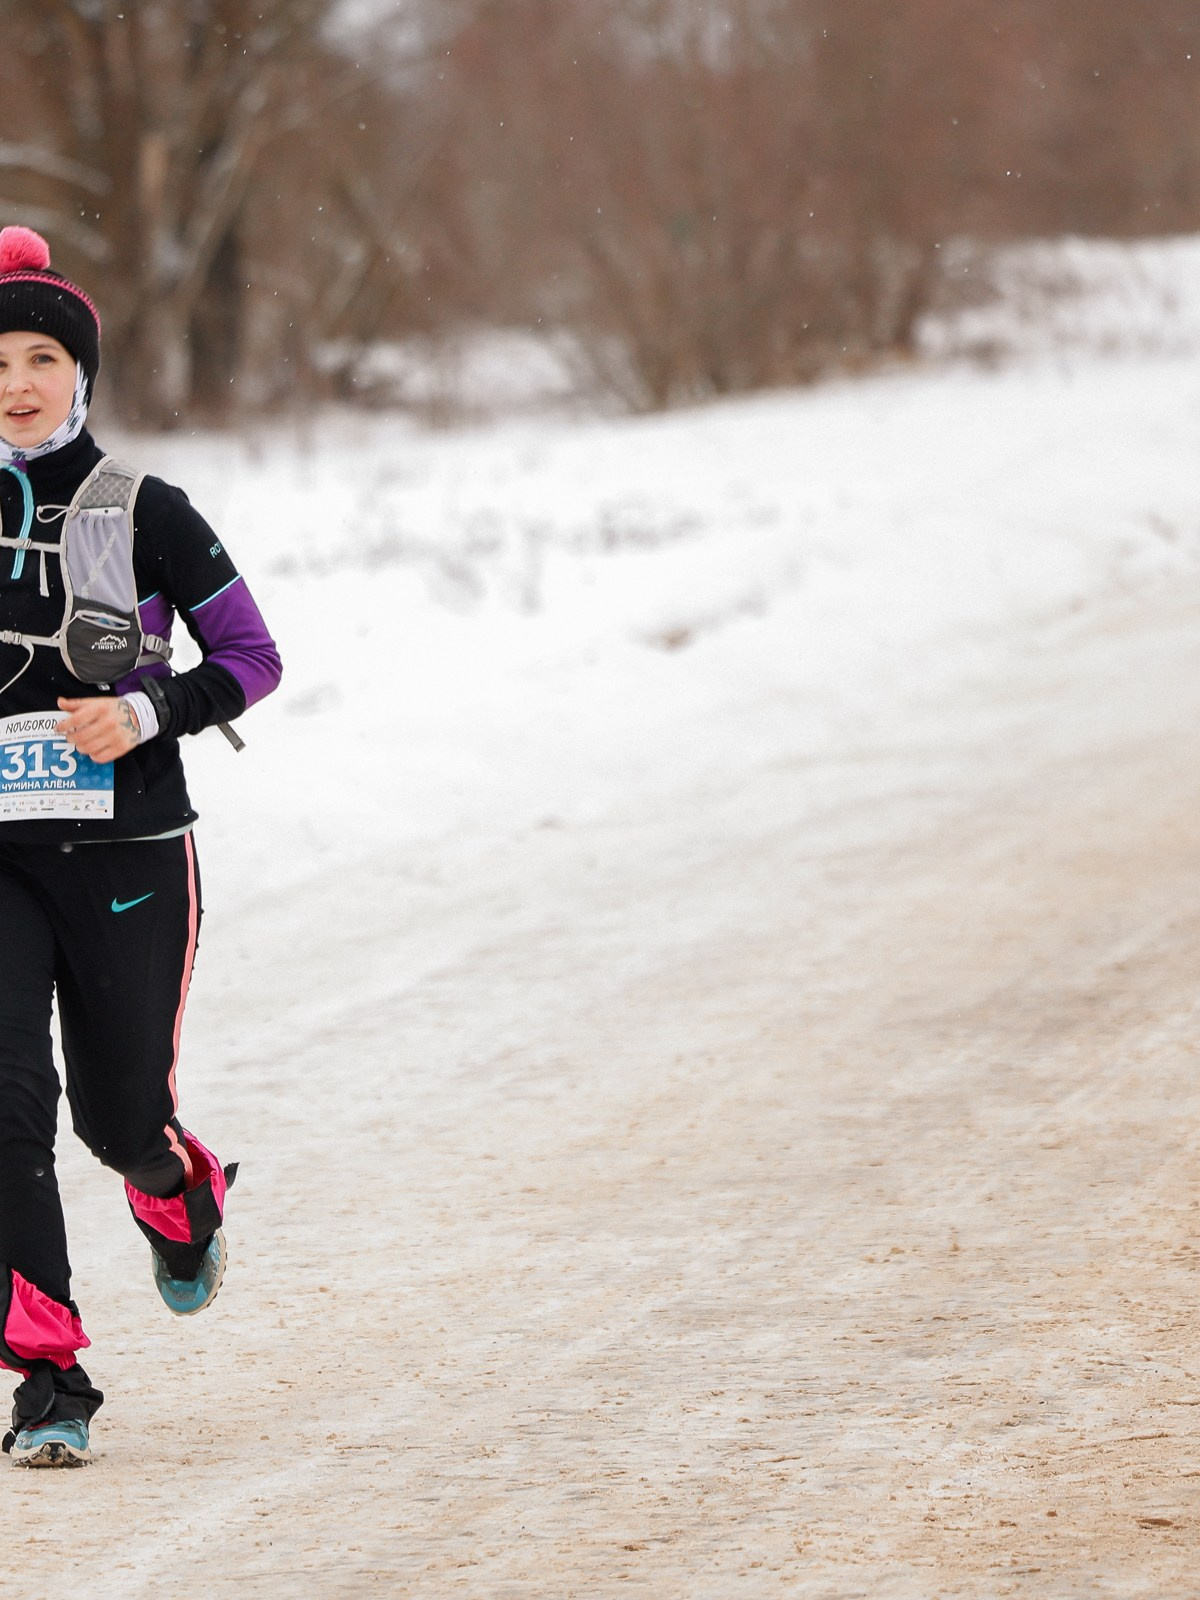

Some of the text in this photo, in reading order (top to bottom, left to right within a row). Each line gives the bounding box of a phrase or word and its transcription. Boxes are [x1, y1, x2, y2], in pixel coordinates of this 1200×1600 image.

[6, 718, 58, 734] NOVGOROD
[1, 742, 77, 780] 313
[1, 779, 77, 791] ЧУМИНА АЛЁНА
